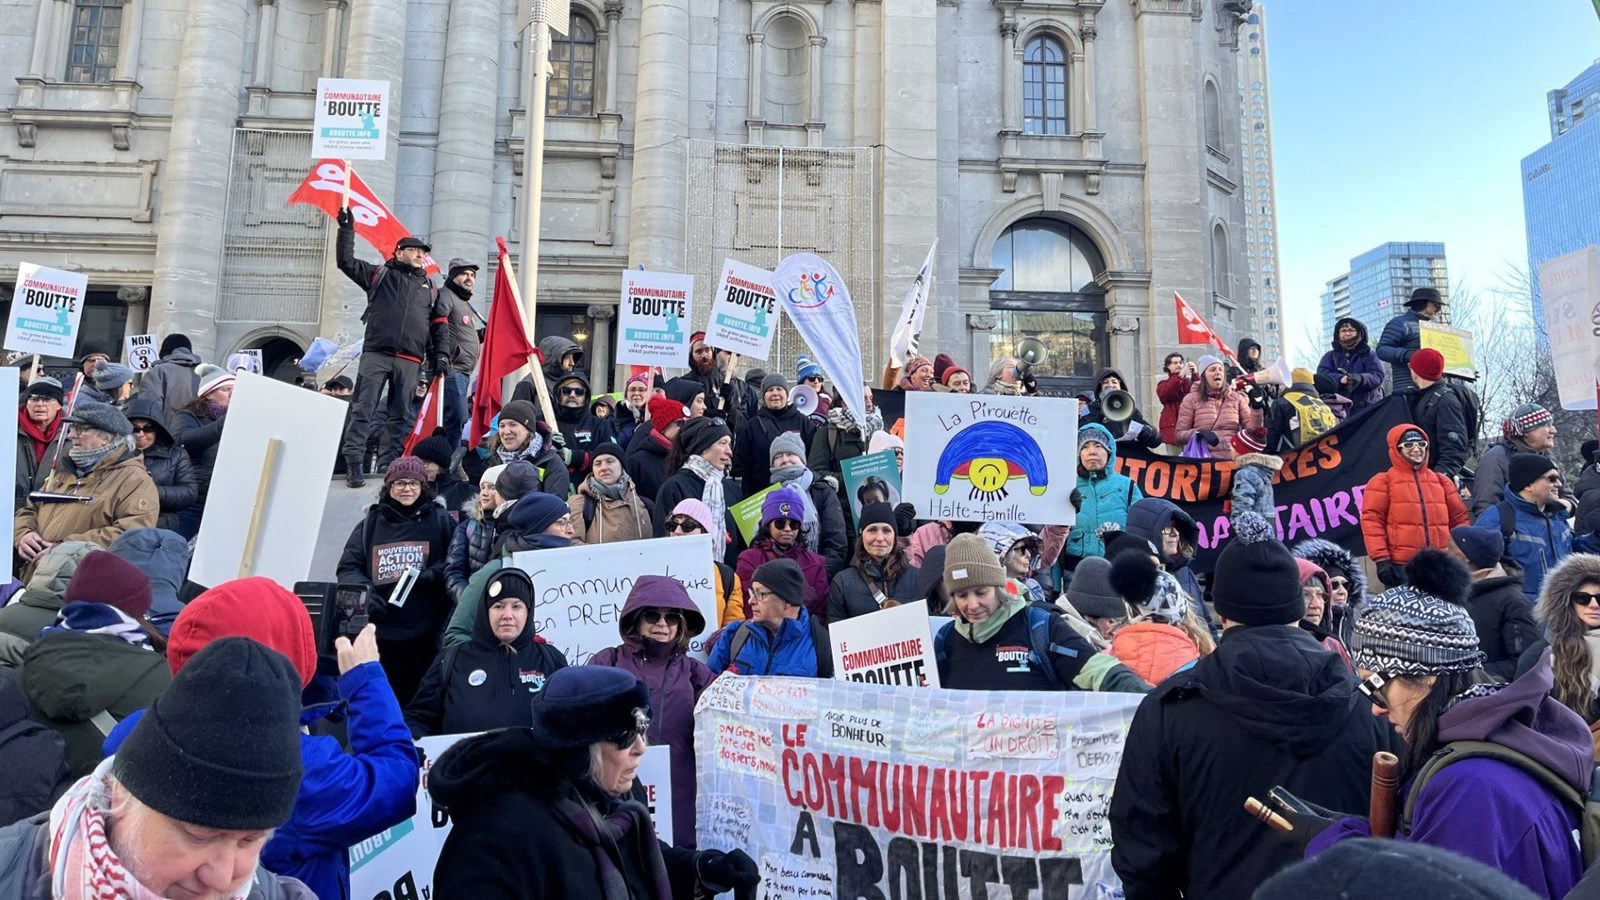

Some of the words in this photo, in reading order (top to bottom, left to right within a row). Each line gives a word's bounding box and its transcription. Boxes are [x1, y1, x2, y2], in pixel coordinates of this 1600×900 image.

[324, 92, 382, 101] COMMUNAUTAIRE
[328, 101, 381, 118] BOUTTE
[24, 279, 79, 296] COMMUNAUTAIRE
[628, 287, 686, 300] COMMUNAUTAIRE
[727, 276, 776, 297] COMMUNAUTAI
[25, 288, 77, 313] BOUTTE
[632, 297, 685, 318] BOUTTE
[727, 286, 776, 315] BOUTTE
[723, 316, 761, 334] ABOUTTE.INFO
[131, 336, 152, 346] NON
[634, 331, 675, 341] ABOUTTE.INFO
[135, 349, 151, 357] LOI
[139, 356, 149, 370] 3
[938, 414, 961, 431] La
[1112, 436, 1341, 502] TORITRES
[930, 499, 1027, 521] Halte-famille
[378, 546, 423, 556] MOUVEMENT
[379, 552, 424, 567] ACTION
[840, 642, 848, 653] LE
[842, 638, 923, 671] COMMUNAUTAIRE
[998, 652, 1029, 662] BOUTTE
[850, 715, 868, 726] PLUS
[977, 713, 995, 729] LA
[782, 724, 808, 749] LE
[831, 722, 887, 748] BONHEUR
[740, 740, 756, 752] des
[782, 749, 1065, 854] COMMUNAUTAIRE
[790, 803, 820, 858] À
